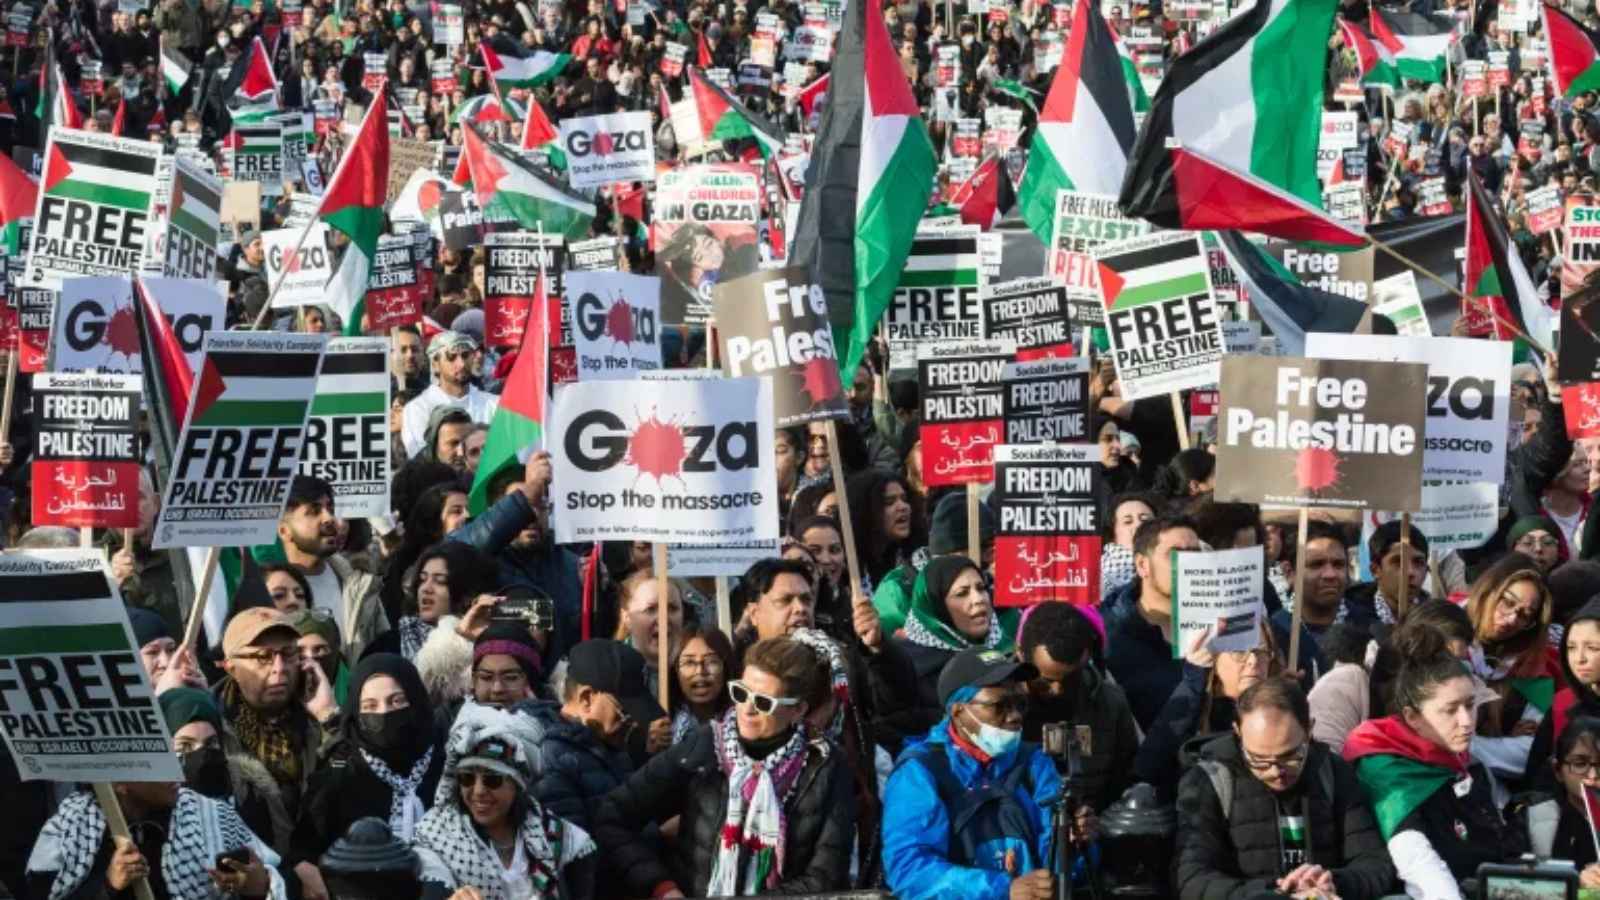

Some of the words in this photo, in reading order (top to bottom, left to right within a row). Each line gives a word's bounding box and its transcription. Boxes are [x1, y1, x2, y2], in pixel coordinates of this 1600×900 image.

[567, 130, 646, 157] Gza
[234, 155, 281, 172] FREE
[37, 197, 148, 251] FREE
[662, 204, 685, 221] IN
[692, 203, 754, 221] GAZA
[35, 236, 142, 271] PALESTINE
[269, 244, 325, 273] Gza
[491, 249, 554, 268] FREEDOM
[1283, 249, 1339, 273] Free
[576, 292, 656, 344] Gza
[887, 287, 980, 322] FREE
[991, 292, 1059, 321] FREEDOM
[65, 299, 213, 353] Ga
[889, 322, 980, 339] PALESTINE
[1108, 294, 1216, 350] FREE
[1116, 331, 1221, 369] PALESTINE
[927, 360, 1007, 386] FREEDOM
[1011, 378, 1081, 408] FREEDOM
[1277, 367, 1368, 410] Free
[43, 395, 130, 421] FREEDOM
[564, 409, 760, 473] Gza
[1007, 413, 1085, 444] PALESTINE
[1226, 407, 1416, 456] Palestine
[39, 434, 133, 457] PALESTINE
[175, 428, 303, 480] FREE
[169, 479, 289, 506] PALESTINE
[1005, 467, 1091, 493] FREEDOM
[567, 491, 616, 511] Stop
[622, 489, 656, 509] the
[662, 490, 763, 511] massacre
[1000, 506, 1096, 532] PALESTINE
[1017, 543, 1080, 567] الحرية
[1009, 567, 1089, 593] لفلسطين
[0, 653, 153, 711] FREE
[1, 709, 163, 738] PALESTINE
